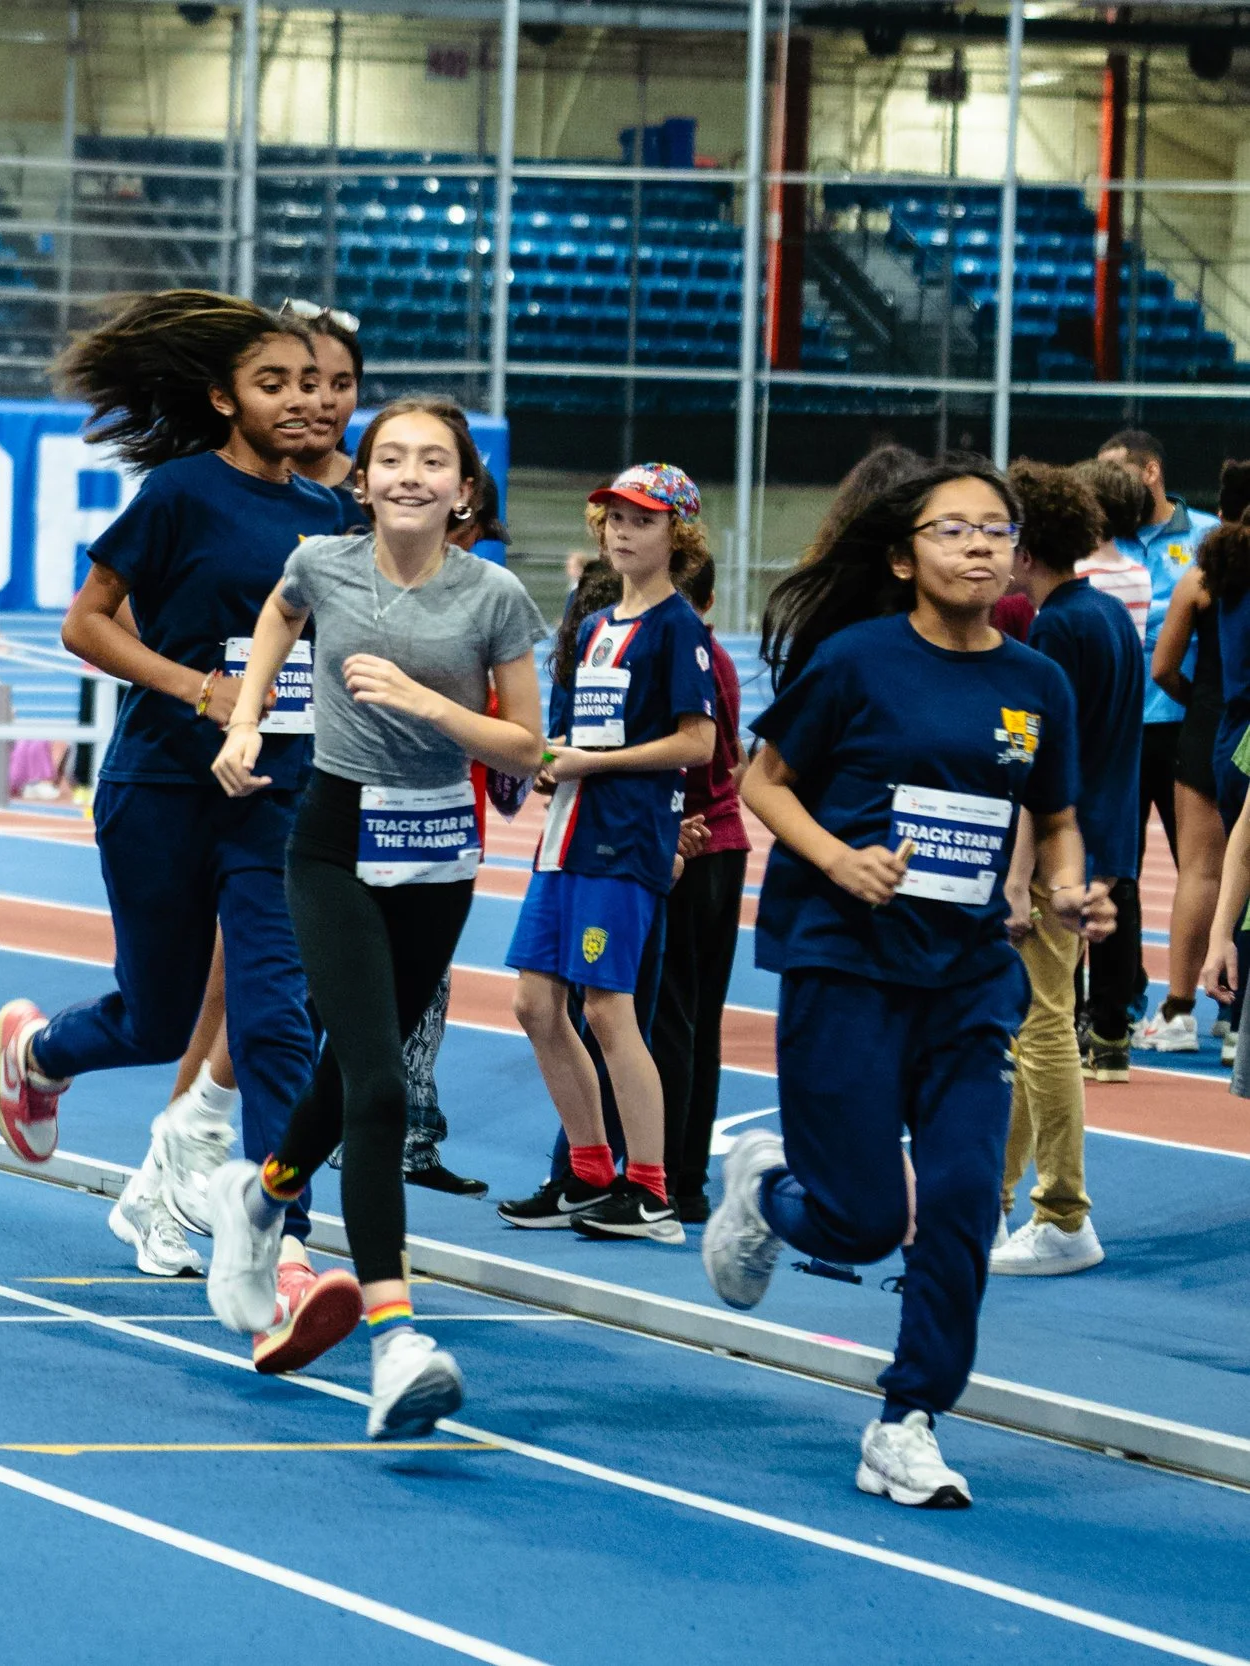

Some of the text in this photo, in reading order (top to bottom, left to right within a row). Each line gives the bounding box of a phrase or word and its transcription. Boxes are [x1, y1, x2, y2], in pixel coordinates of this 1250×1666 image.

[582, 692, 609, 705] STAR
[609, 692, 623, 705] IN
[365, 814, 475, 834] TRACK STAR IN
[373, 831, 468, 849] THE MAKING
[895, 820, 1003, 851] TRACK STAR IN
[937, 844, 993, 866] MAKING
